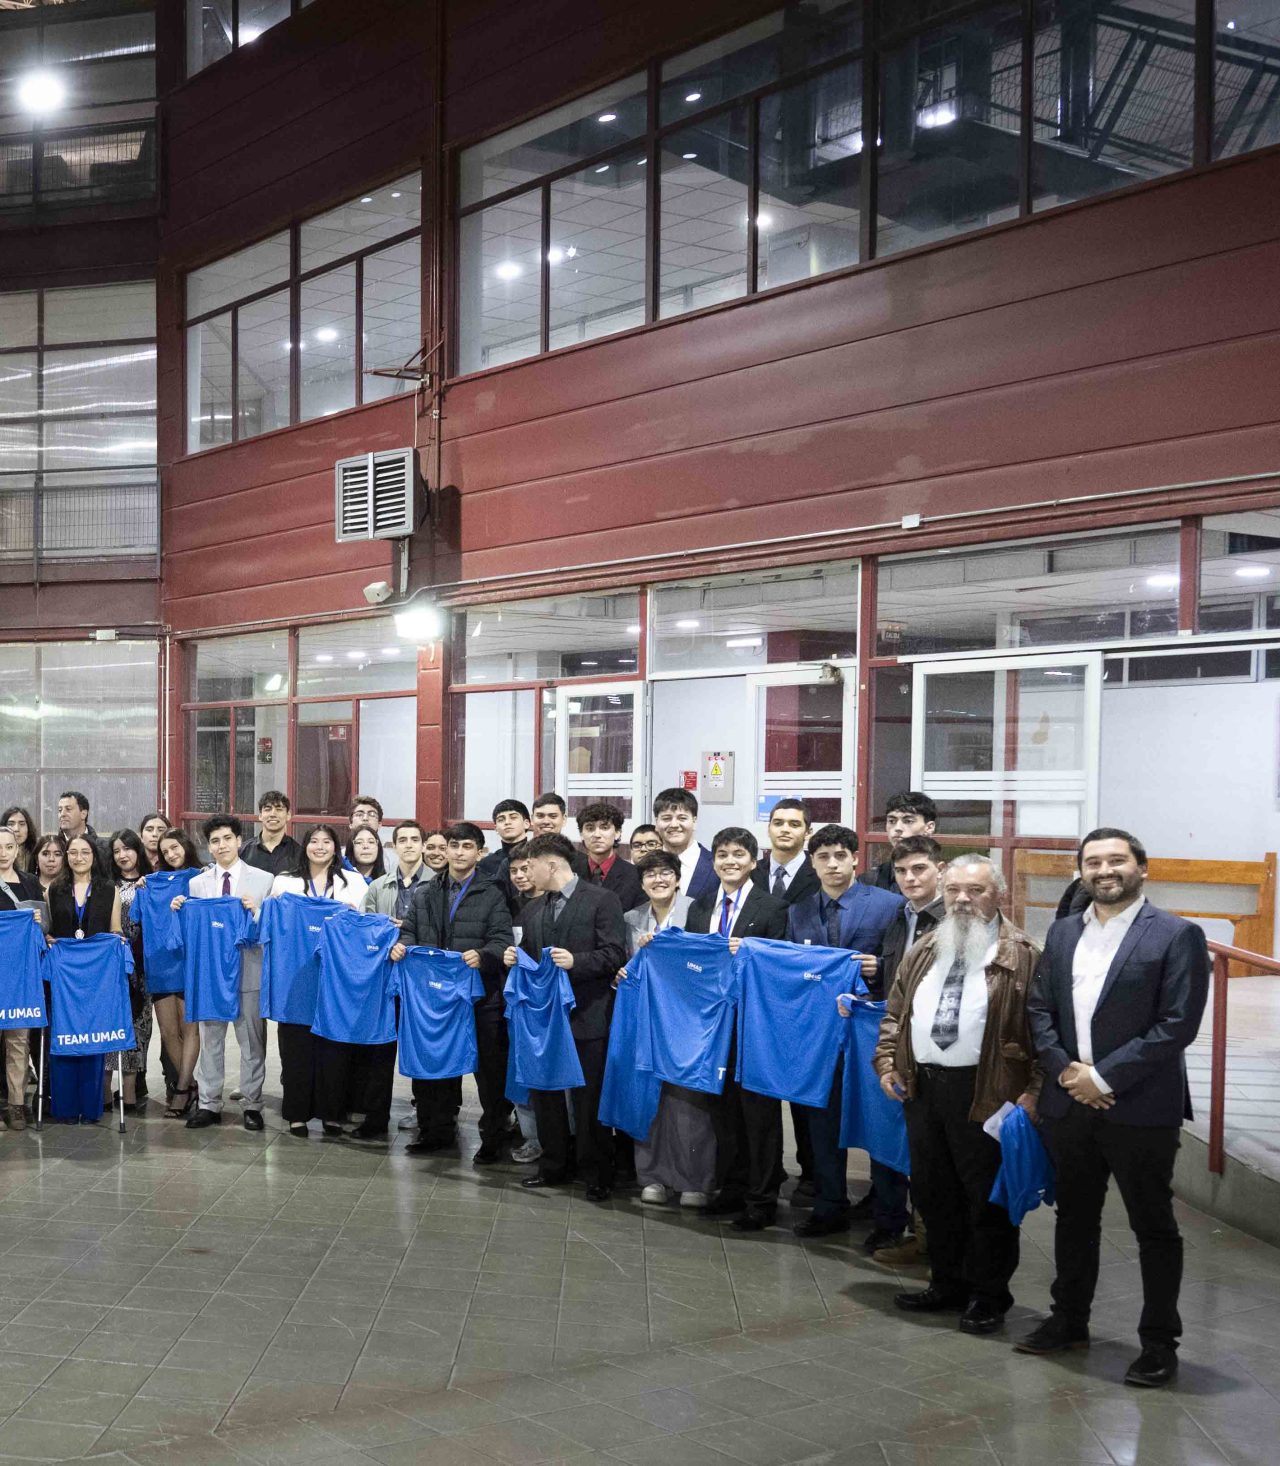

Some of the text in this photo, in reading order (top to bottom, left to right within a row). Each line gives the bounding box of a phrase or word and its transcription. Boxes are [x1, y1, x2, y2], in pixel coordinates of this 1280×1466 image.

[9, 1007, 41, 1019] UMAG
[58, 1029, 125, 1045] TEAM UMAG
